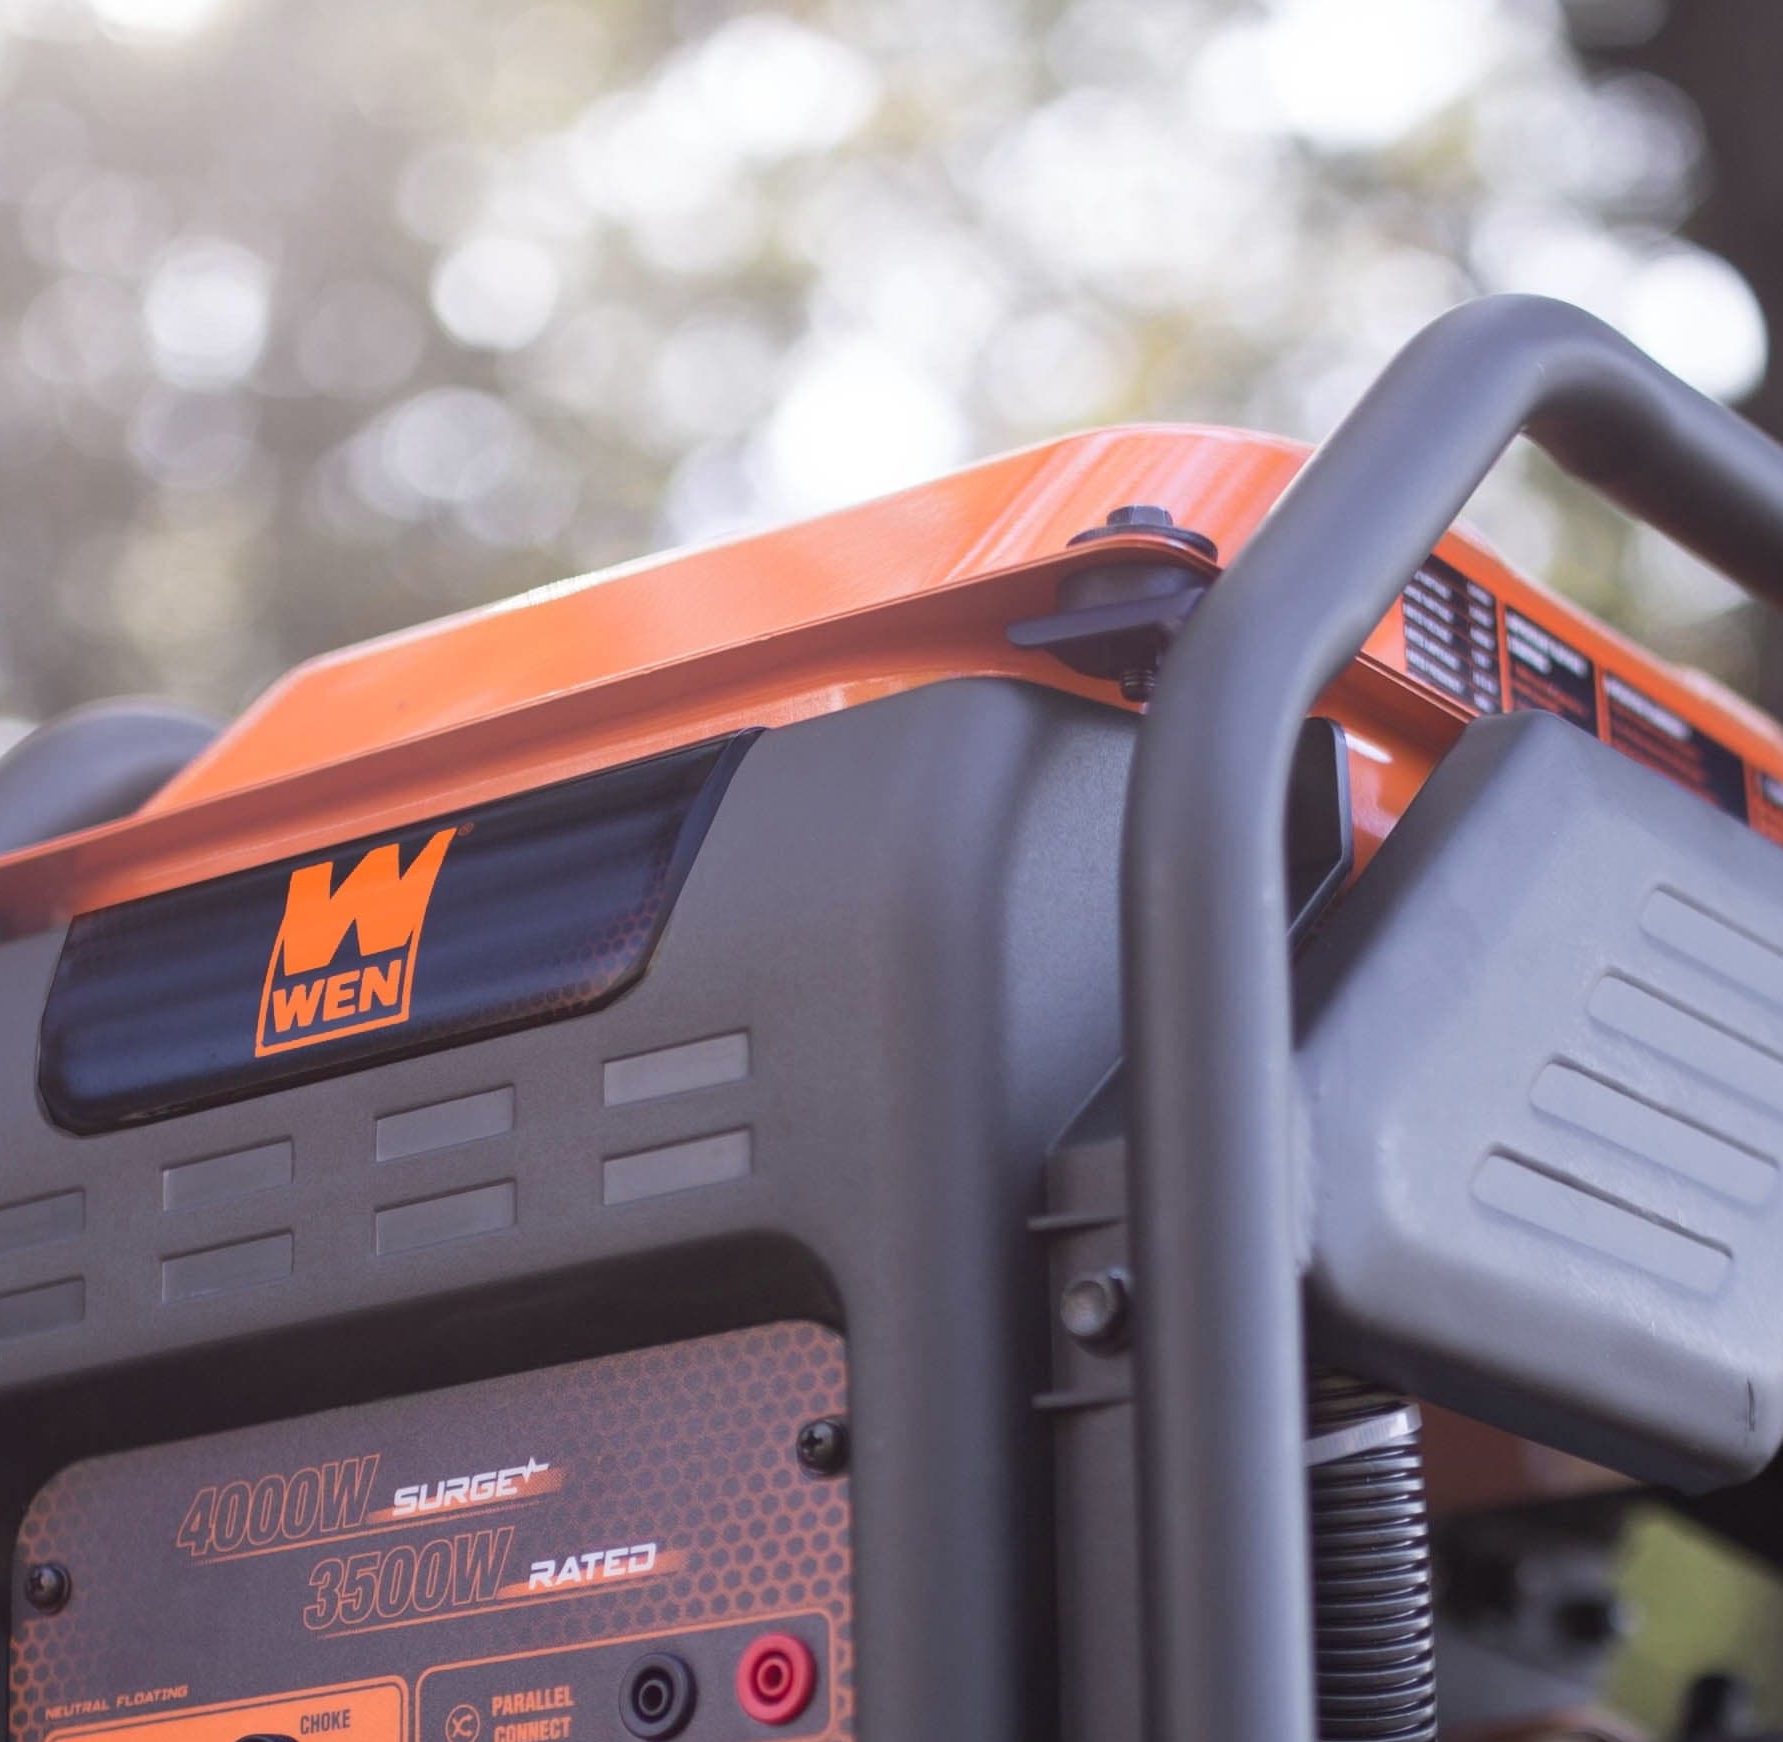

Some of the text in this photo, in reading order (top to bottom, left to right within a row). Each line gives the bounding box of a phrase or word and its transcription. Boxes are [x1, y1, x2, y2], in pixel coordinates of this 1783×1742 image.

[272, 959, 403, 1033] WEN
[175, 1452, 522, 1557] 4000W SURGE
[303, 1526, 658, 1631] 3500W RATED
[45, 1685, 189, 1721] NEUTRAL FLOATING
[300, 1709, 351, 1734] CHOKE
[491, 1685, 576, 1718] PARALLEL
